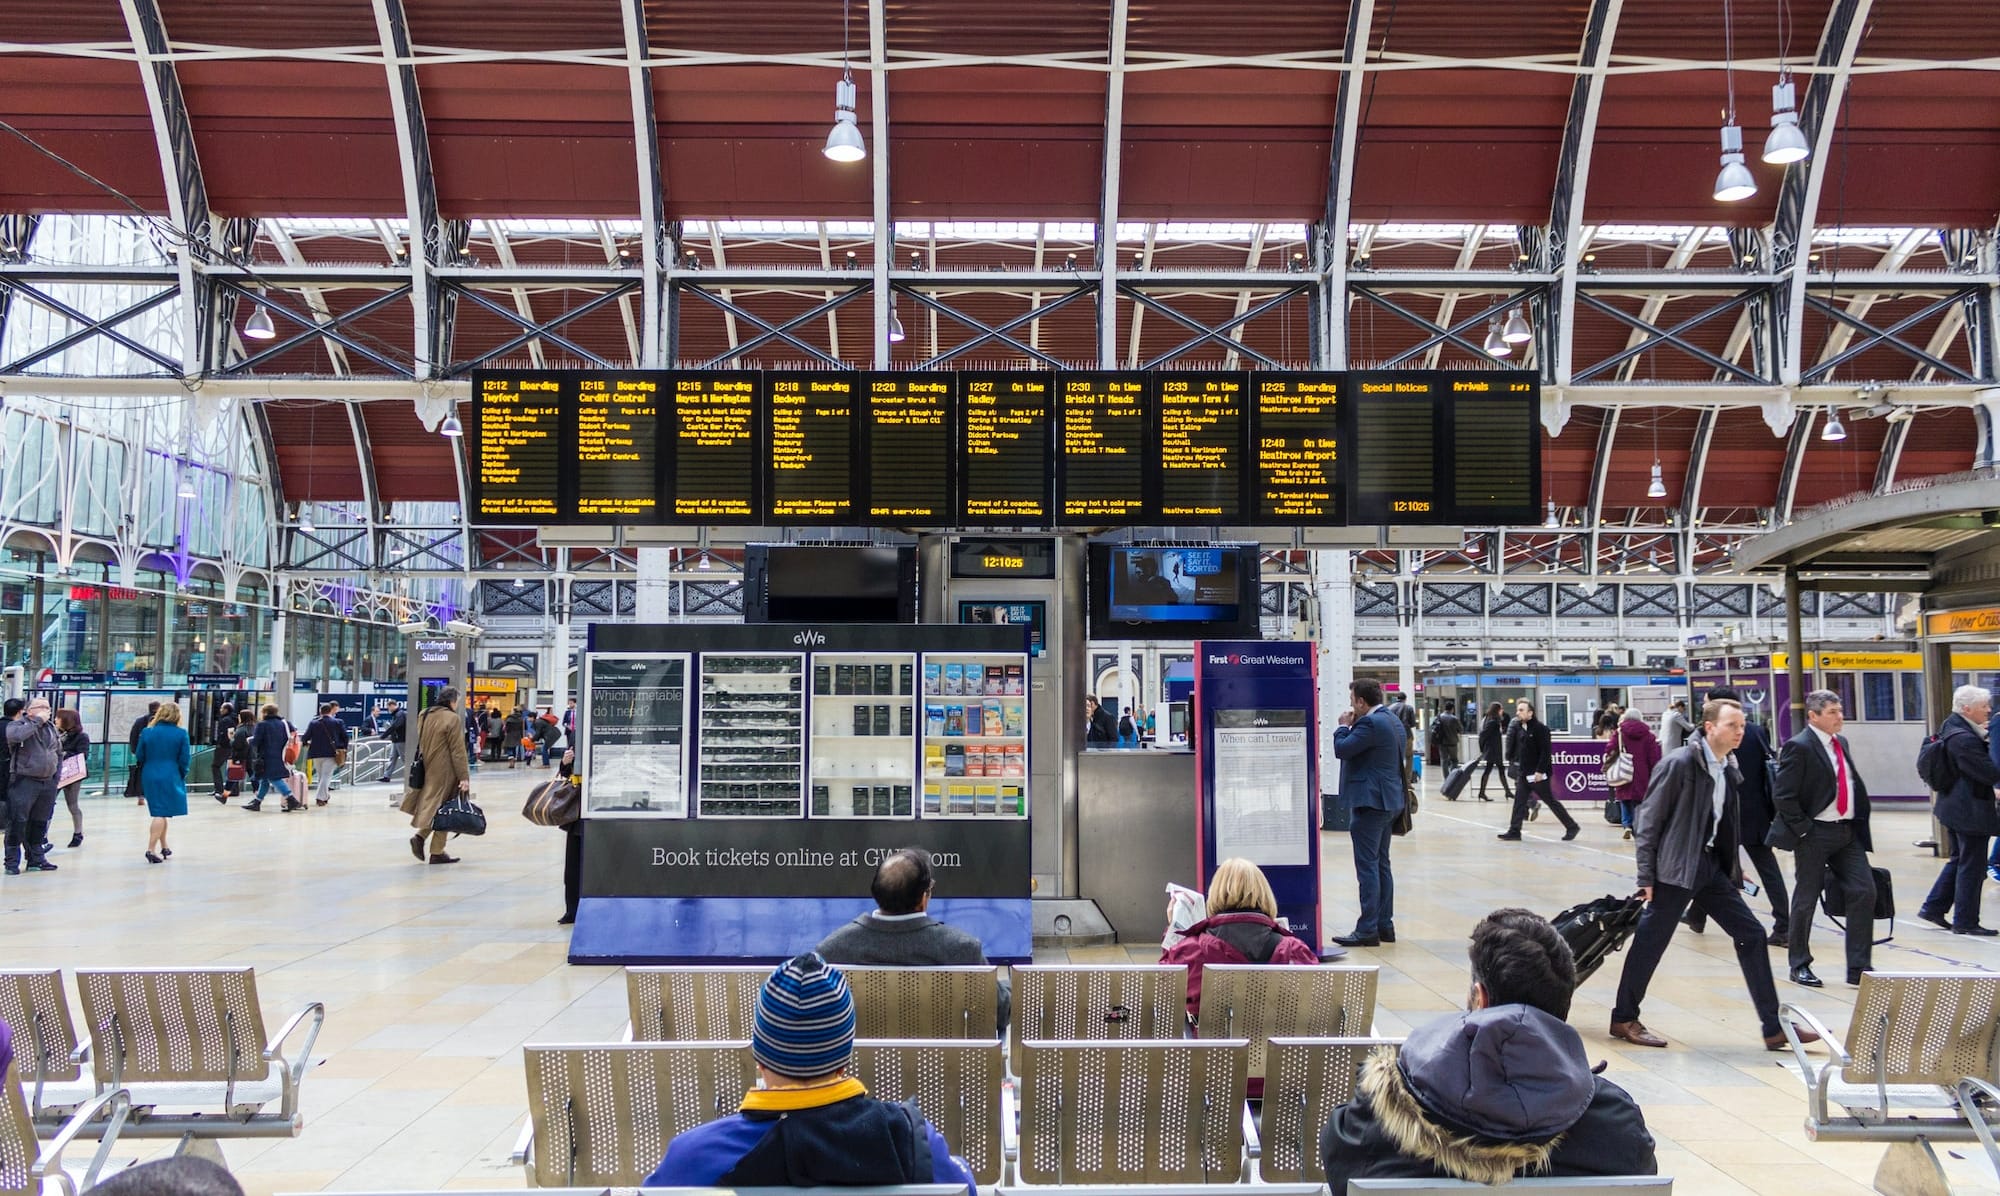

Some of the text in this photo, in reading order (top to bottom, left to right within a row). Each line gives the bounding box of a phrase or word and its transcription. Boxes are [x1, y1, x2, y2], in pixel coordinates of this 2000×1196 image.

[483, 381, 559, 392] 12:12 Boarding
[580, 381, 656, 392] 12:15 Boarding
[678, 382, 752, 392] 12:15 Boarding
[775, 382, 850, 392] 12:18 Boarding
[872, 383, 948, 393] 12:20 Boarding
[970, 383, 1044, 392] 12:27 On time
[1067, 383, 1142, 392] 12:30 On time
[1164, 382, 1239, 392] 12:33 On time
[1262, 383, 1337, 393] 12:25 Boarding
[1362, 384, 1428, 393] Special Notices
[1453, 382, 1489, 391] Arrivals
[483, 393, 520, 403] Twyford
[579, 393, 646, 403] Cardiff Central
[676, 394, 700, 404] Hayes
[710, 394, 751, 404] Harlington
[773, 394, 806, 404] Bedwyn
[968, 395, 996, 404] Radley
[1065, 394, 1096, 404] Bristol
[1108, 394, 1134, 404] Meads
[1163, 394, 1200, 404] Heathrow
[1203, 394, 1222, 404] Term
[1260, 395, 1336, 404] Heathrow Airport
[1262, 439, 1336, 448] 12:40 On time
[1260, 451, 1336, 460] Heathrow Airport
[793, 629, 826, 646] GWR
[416, 641, 455, 651] Paddington
[422, 652, 448, 661] Station
[1209, 655, 1304, 664] First Great Western
[1832, 657, 1854, 665] Flight
[594, 690, 682, 700] Which timetable
[593, 705, 608, 717] do
[617, 705, 650, 717] need?
[1220, 735, 1247, 744] When
[1272, 734, 1301, 743] travel?
[652, 848, 700, 866] Book
[706, 848, 769, 866] tickets
[775, 848, 834, 866] online
[839, 850, 858, 866] at
